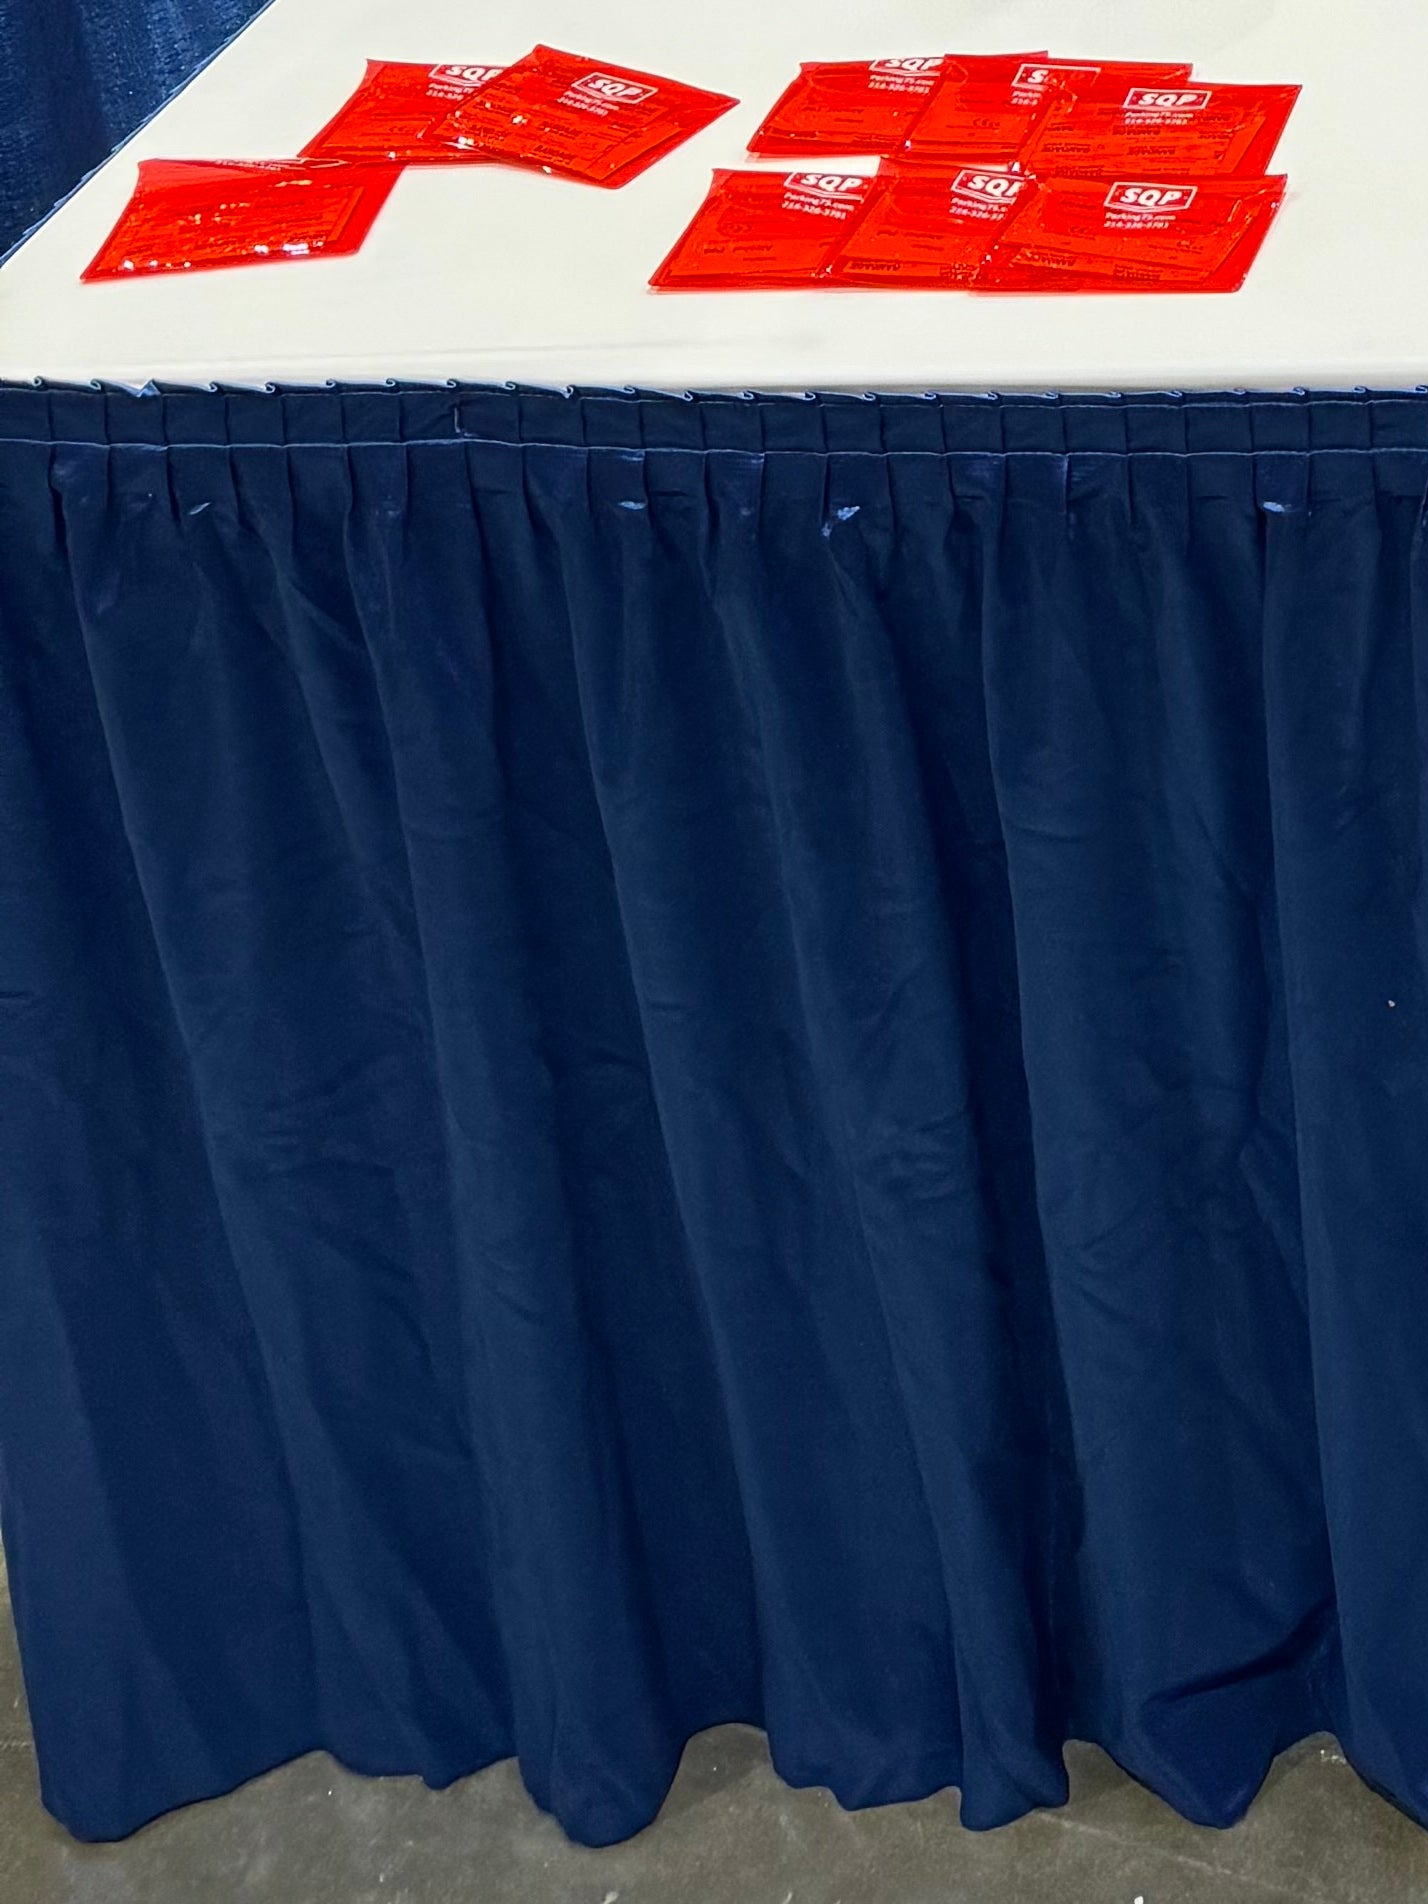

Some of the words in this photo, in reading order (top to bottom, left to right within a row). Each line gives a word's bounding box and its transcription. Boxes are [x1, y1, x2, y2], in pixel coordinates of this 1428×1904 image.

[884, 57, 945, 72] SQP
[588, 78, 645, 97] SQP
[1138, 92, 1200, 108] SQP
[799, 172, 864, 193] SQP
[783, 191, 855, 212] Parking75.com
[1119, 187, 1184, 206] SQP
